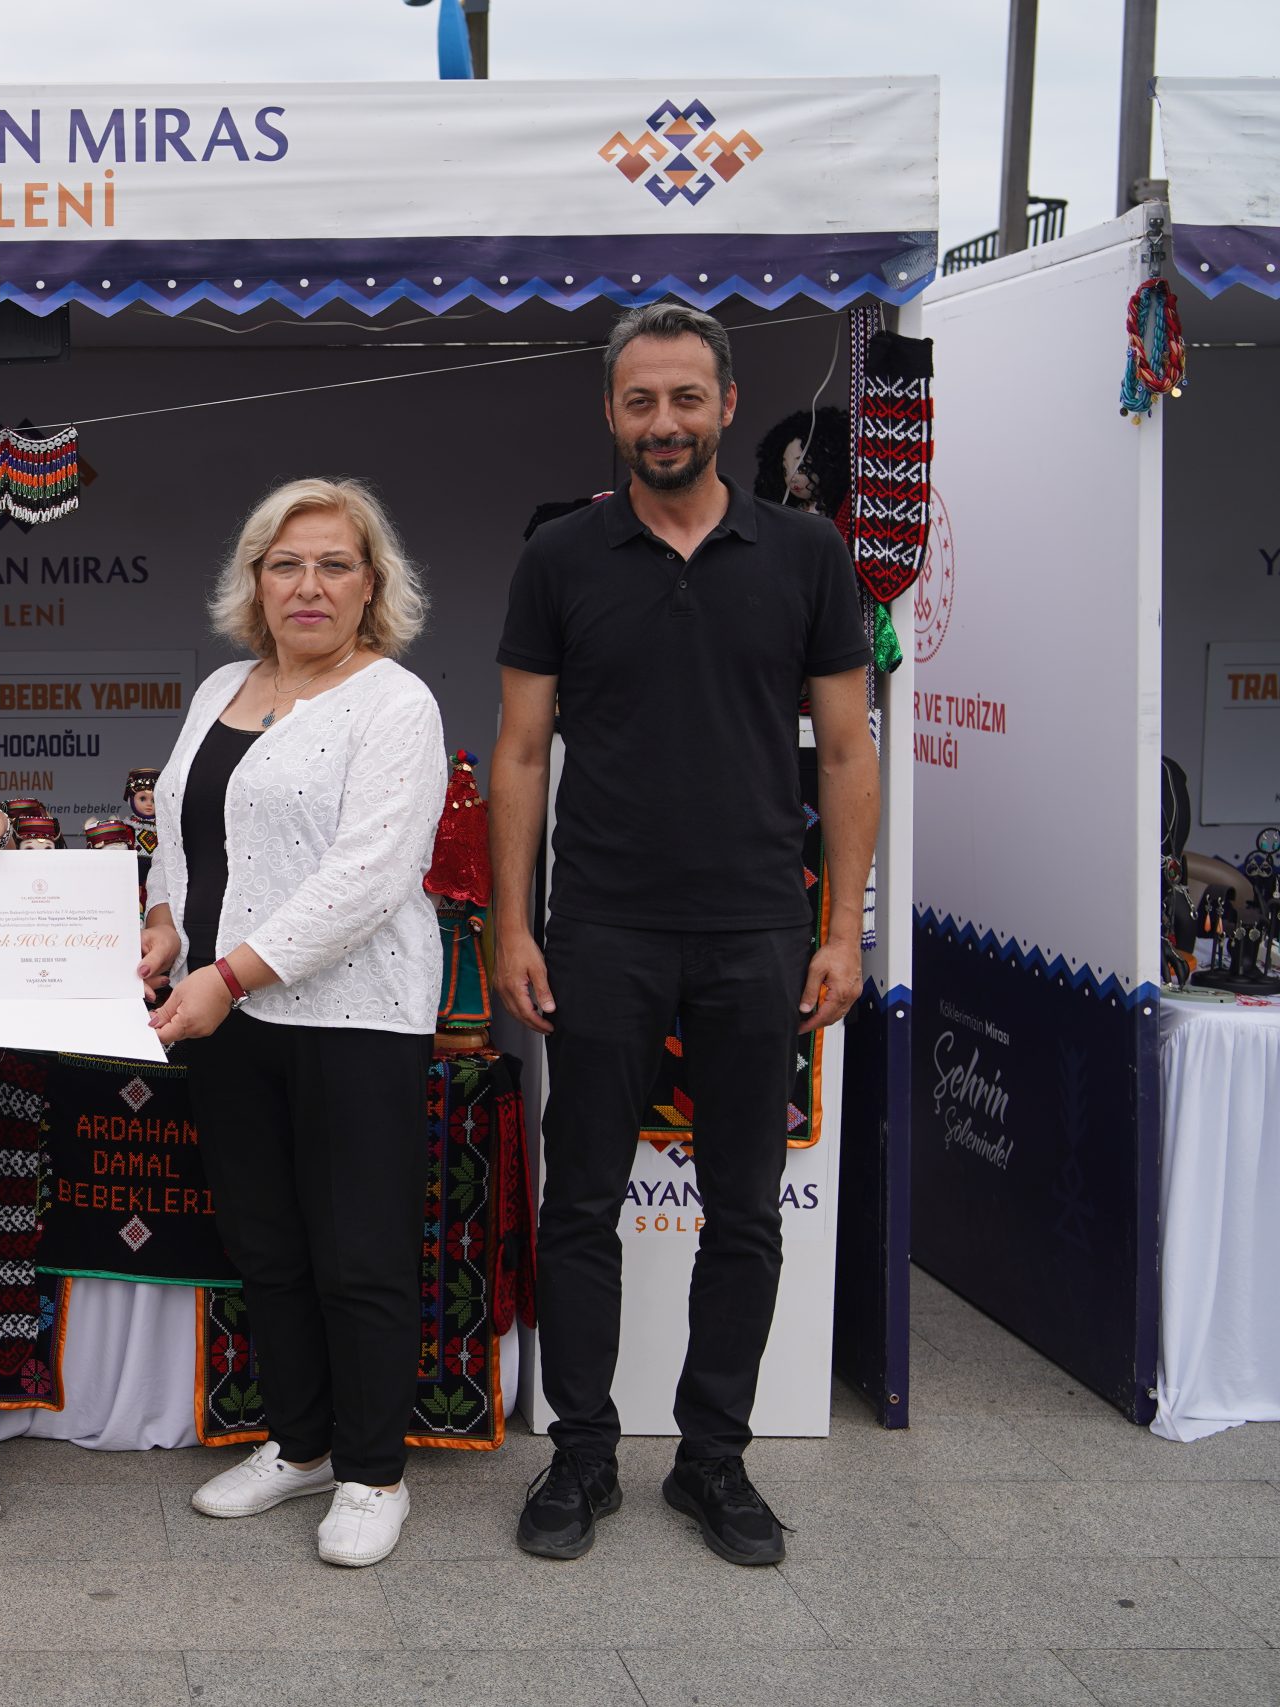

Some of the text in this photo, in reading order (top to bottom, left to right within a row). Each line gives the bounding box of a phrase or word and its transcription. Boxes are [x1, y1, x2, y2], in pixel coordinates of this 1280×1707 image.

[0, 683, 82, 710] BEBEK
[91, 682, 182, 710] YAPIMI
[924, 692, 942, 723] VE
[946, 692, 1006, 734] TURİZM
[73, 803, 122, 815] bebekler
[985, 1019, 1010, 1046] Mirası
[933, 1031, 1010, 1124] Şehrin
[76, 1114, 199, 1145] ARDAHAN
[93, 1150, 180, 1179] DAMAL
